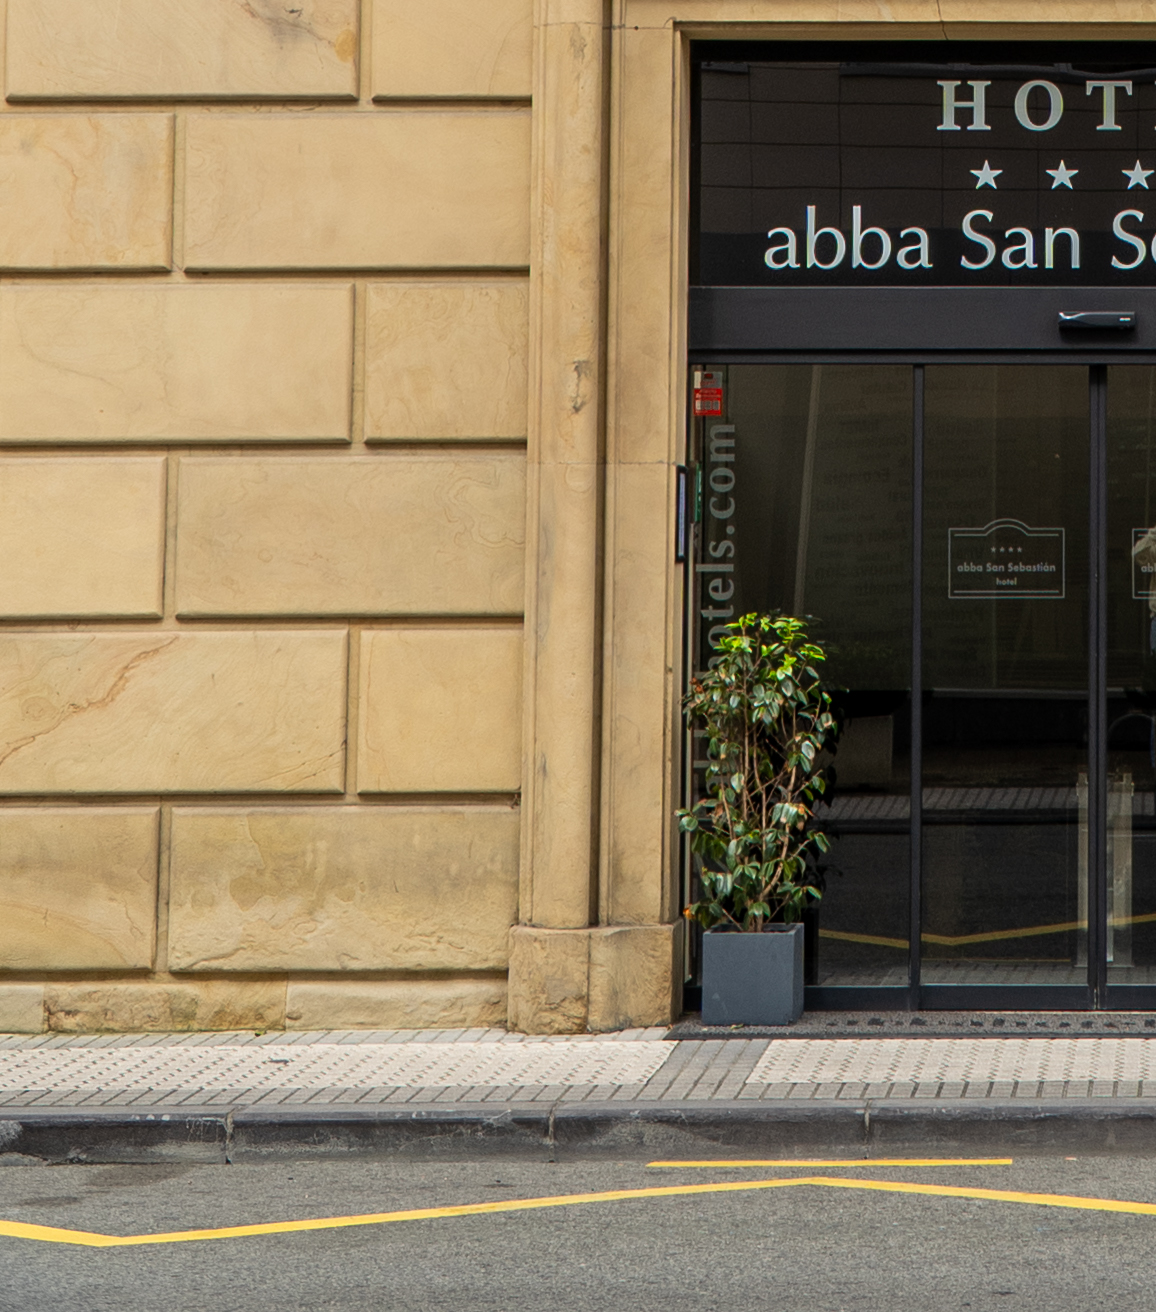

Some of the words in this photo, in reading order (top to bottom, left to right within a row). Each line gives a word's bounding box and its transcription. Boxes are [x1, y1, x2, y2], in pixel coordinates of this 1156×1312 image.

[764, 205, 933, 271] abba
[960, 209, 1081, 271] San
[957, 561, 983, 572] abba
[986, 561, 1005, 572] San
[1007, 561, 1056, 572] Sebastián
[996, 577, 1018, 586] hotel
